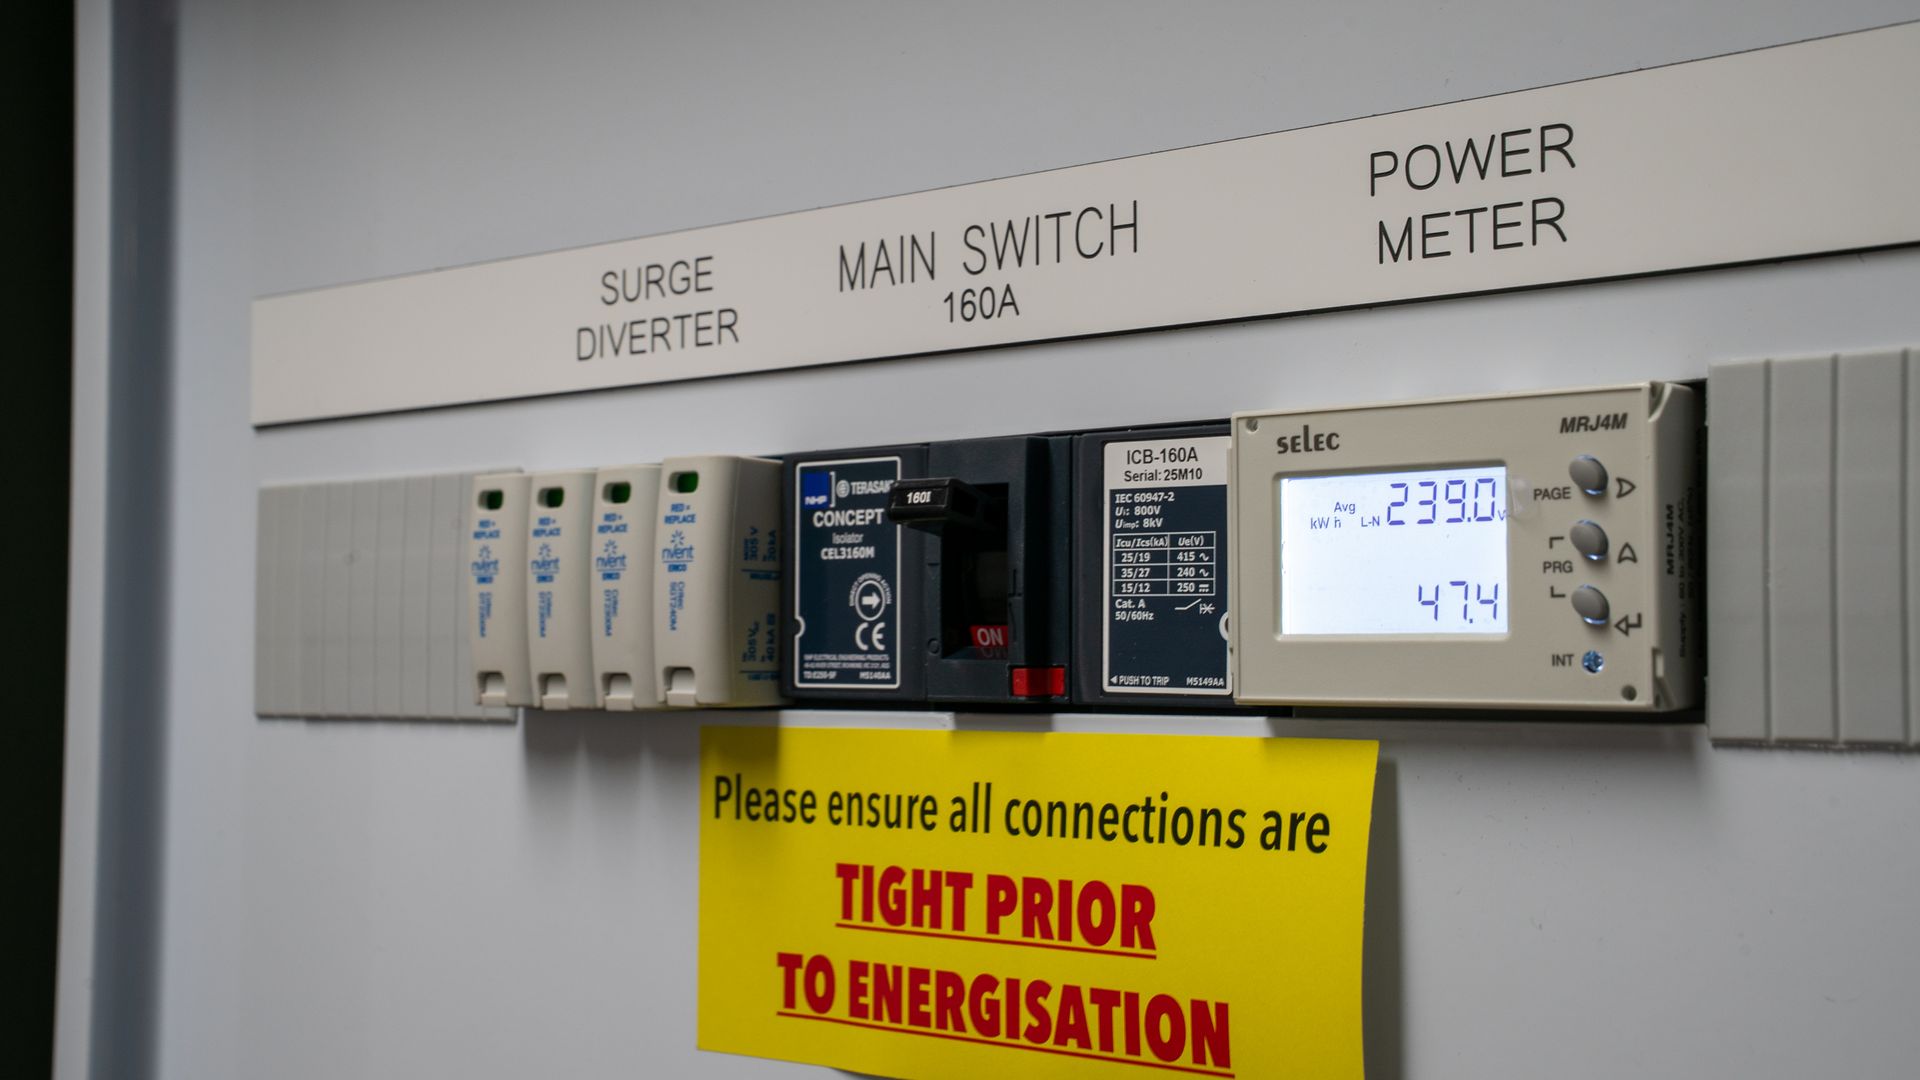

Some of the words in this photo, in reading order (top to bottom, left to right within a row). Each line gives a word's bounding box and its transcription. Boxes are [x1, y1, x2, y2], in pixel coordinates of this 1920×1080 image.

[1370, 122, 1576, 197] POWER
[1378, 196, 1568, 265] METER
[839, 230, 936, 293] MAIN
[961, 199, 1138, 277] SWITCH
[600, 255, 715, 307] SURGE
[943, 282, 1020, 324] 160A
[576, 307, 740, 362] DIVERTER
[1559, 412, 1628, 435] MRJ4M
[1126, 447, 1199, 465] ICB-160A
[1124, 470, 1162, 482] Serial:
[1163, 467, 1203, 481] 25M10
[850, 478, 895, 496] TERASAK
[1533, 486, 1572, 501] PAGE
[1115, 493, 1133, 503] IEC
[1133, 492, 1175, 503] 60947-2
[1387, 477, 1496, 527] 239.0
[1134, 505, 1161, 516] 800V
[1333, 501, 1356, 515] Avg
[664, 513, 696, 524] REPLACE
[813, 507, 884, 528] CONCEPT
[1142, 518, 1163, 528] 8kV
[1361, 515, 1381, 528] L-N
[597, 523, 628, 534] REPLACE
[832, 532, 864, 545] Isolator
[1177, 535, 1205, 547] Ue(V)
[1666, 504, 1675, 575] MRJ4M
[820, 546, 875, 560] CEL3160M
[1121, 552, 1151, 564] 25/19
[1177, 552, 1196, 561] 415
[1121, 567, 1151, 579] 35/27
[1177, 567, 1196, 577] 240
[1543, 560, 1574, 574] PRG
[1121, 582, 1151, 594] 15/12
[1177, 582, 1195, 593] 250
[1115, 599, 1135, 609] Cat.
[1137, 599, 1146, 609] A
[1418, 579, 1499, 624] 47.4
[1115, 610, 1154, 622] 50/60Hz
[976, 627, 1004, 647] ON
[1551, 653, 1575, 667] INT
[1119, 675, 1139, 685] PUSH
[1140, 675, 1151, 685] TO
[1152, 675, 1170, 686] TRIP
[713, 772, 818, 825] Please
[826, 787, 938, 832] ensure
[948, 781, 993, 835] all
[1003, 790, 1246, 851] connections
[1258, 809, 1331, 855] are
[835, 862, 974, 933] TIGHT
[985, 872, 1157, 952] PRIOR
[776, 951, 836, 1015] TO
[848, 958, 1232, 1070] ENERGISATION
